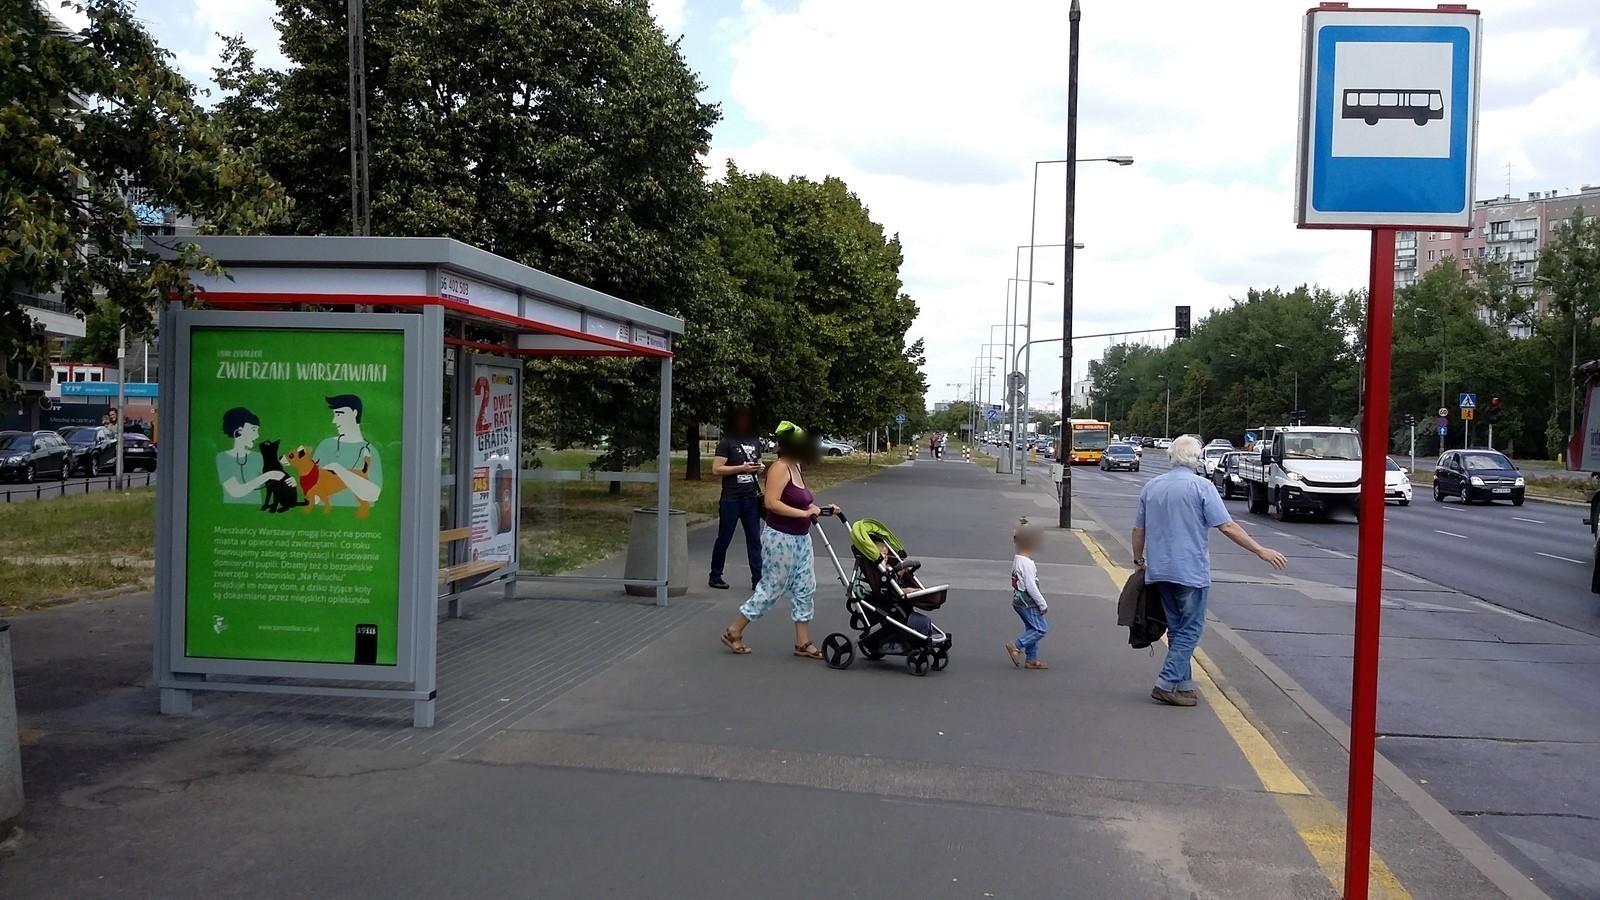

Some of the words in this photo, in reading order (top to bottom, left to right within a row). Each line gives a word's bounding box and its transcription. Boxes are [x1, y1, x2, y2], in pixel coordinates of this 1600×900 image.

[216, 361, 291, 380] ZWIERZAKI
[296, 362, 388, 382] WARSZAWIAKI
[473, 376, 492, 436] 2
[493, 393, 512, 411] DWIE
[494, 409, 512, 428] RATY
[478, 425, 513, 452] GRATIS!
[214, 526, 257, 537] Mieszkańcy
[258, 527, 296, 539] Warszawy
[355, 531, 382, 540] pomoc
[248, 539, 274, 547] opiece
[275, 539, 290, 547] nad
[340, 540, 351, 549] Co
[352, 541, 370, 549] roku
[257, 583, 279, 592] nowy
